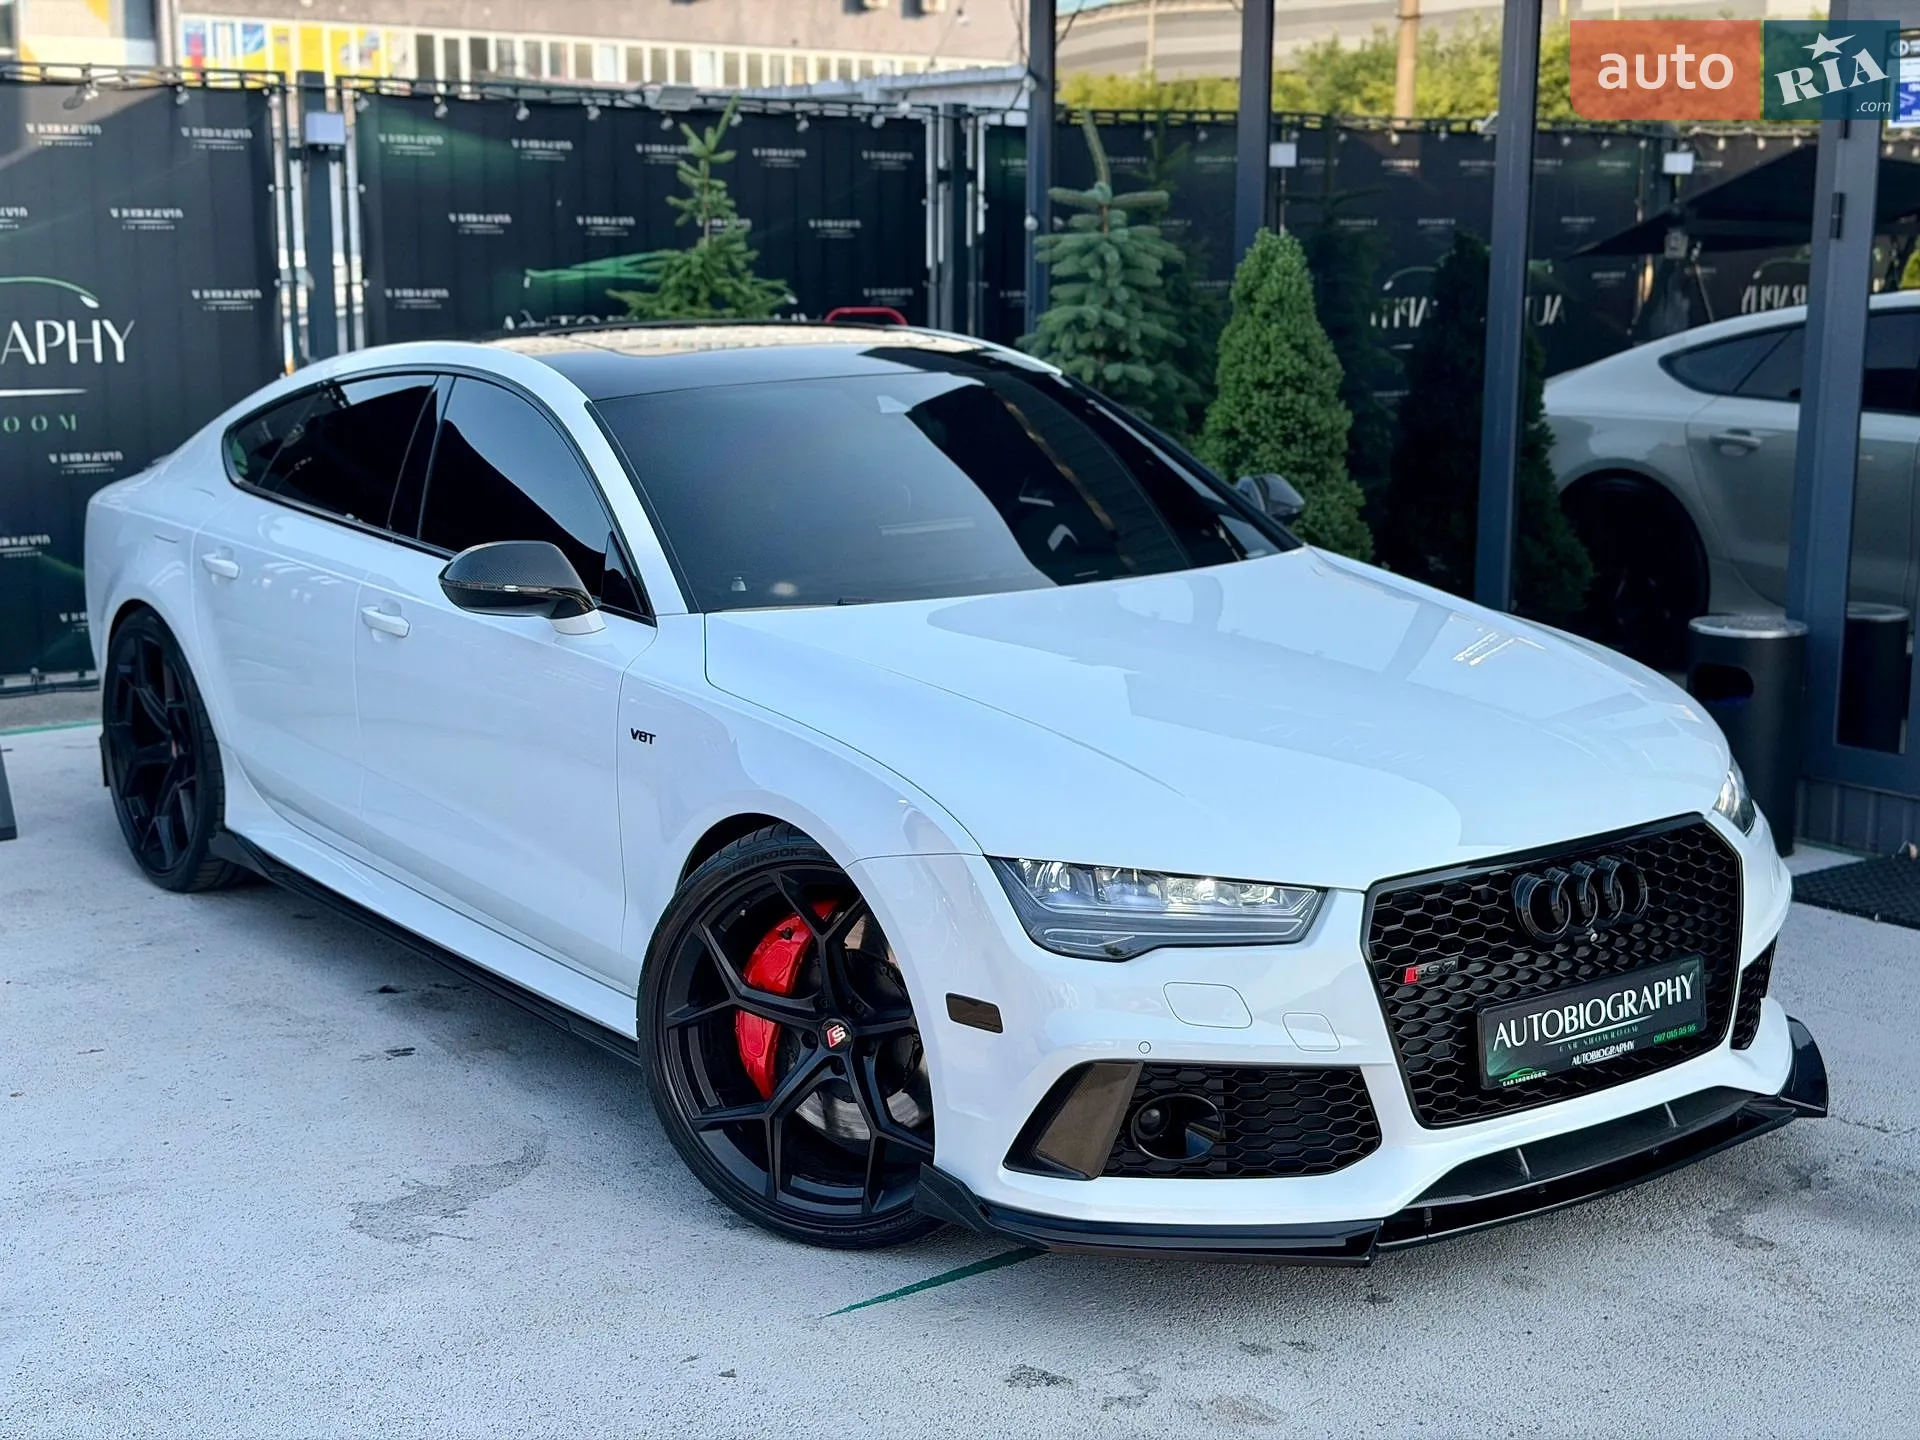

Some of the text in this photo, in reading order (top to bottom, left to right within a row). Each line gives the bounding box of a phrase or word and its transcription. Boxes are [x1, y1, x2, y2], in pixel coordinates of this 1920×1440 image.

[630, 727, 657, 745] V8T
[1493, 972, 1695, 1051] AUTOBIOGRAPHY
[1571, 1040, 1636, 1066] AUTOBIOGRAPHY
